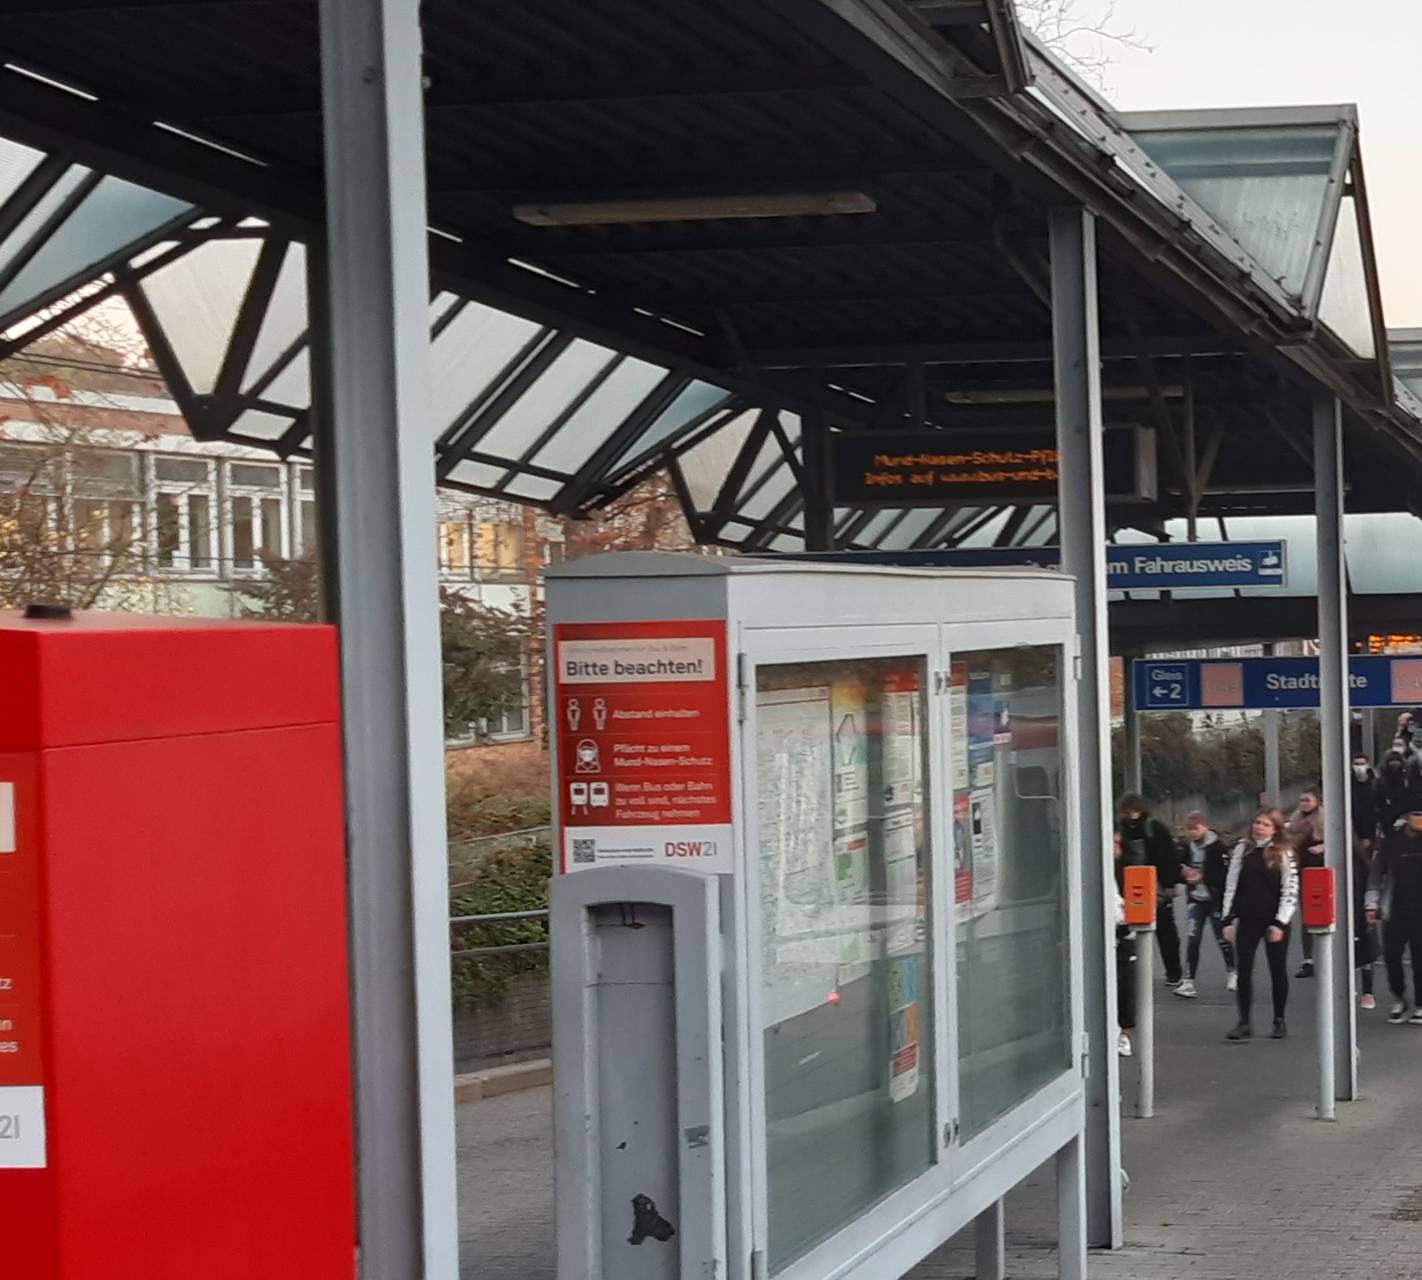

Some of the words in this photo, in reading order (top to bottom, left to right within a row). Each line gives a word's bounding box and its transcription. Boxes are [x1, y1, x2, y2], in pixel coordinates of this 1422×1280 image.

[1134, 555, 1252, 575] Fahrausweis
[566, 661, 609, 677] Bitte
[614, 659, 703, 676] beachten!
[1152, 669, 1183, 681] Gleis
[1170, 684, 1182, 699] 2
[613, 710, 654, 719] Abstand
[655, 709, 700, 719] einhalten
[614, 744, 646, 753] Pflicht
[647, 745, 659, 753] zu
[661, 743, 690, 753] einem
[614, 756, 713, 767] Mund-Nasen-Schutz
[643, 782, 661, 792] Bus
[662, 782, 685, 792] oder
[687, 781, 713, 791] Bahn
[615, 809, 660, 821] Fahrzeug
[661, 809, 700, 818] nehmen
[664, 842, 718, 858] DSW21
